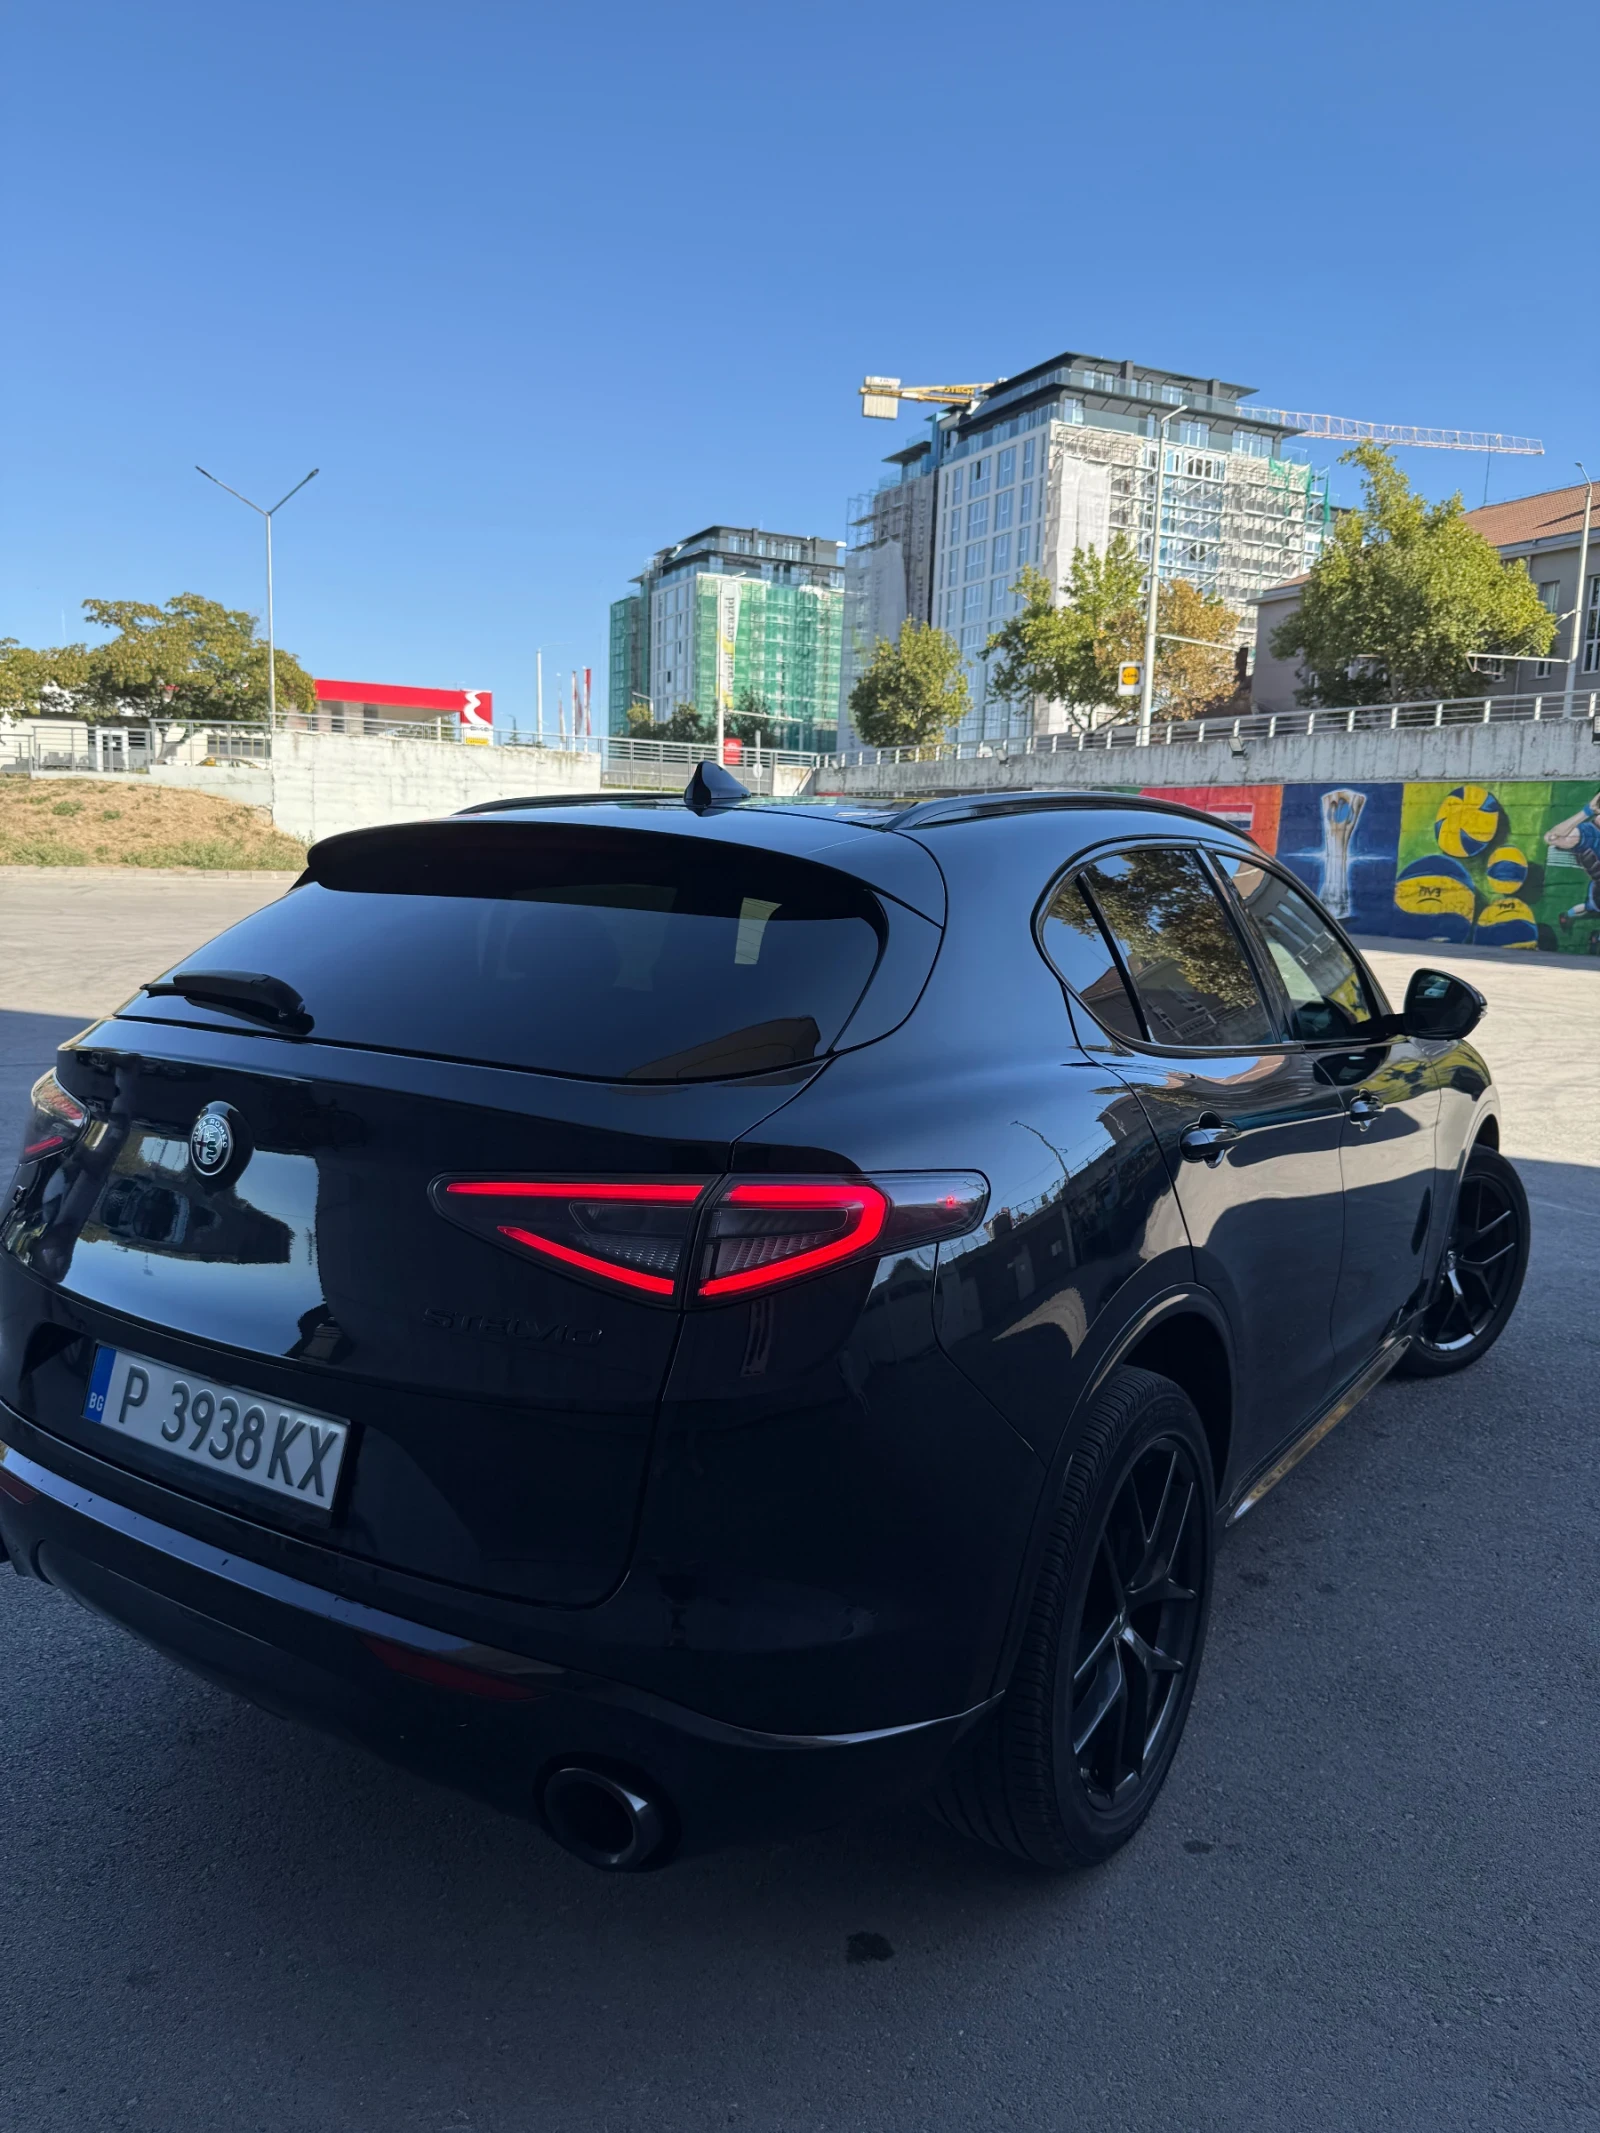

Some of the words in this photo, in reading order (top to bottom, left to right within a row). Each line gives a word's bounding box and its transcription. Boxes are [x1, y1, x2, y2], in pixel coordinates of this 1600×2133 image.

[210, 1118, 228, 1148] ROMEO
[422, 1307, 604, 1347] STELVIO
[88, 1391, 105, 1412] BG
